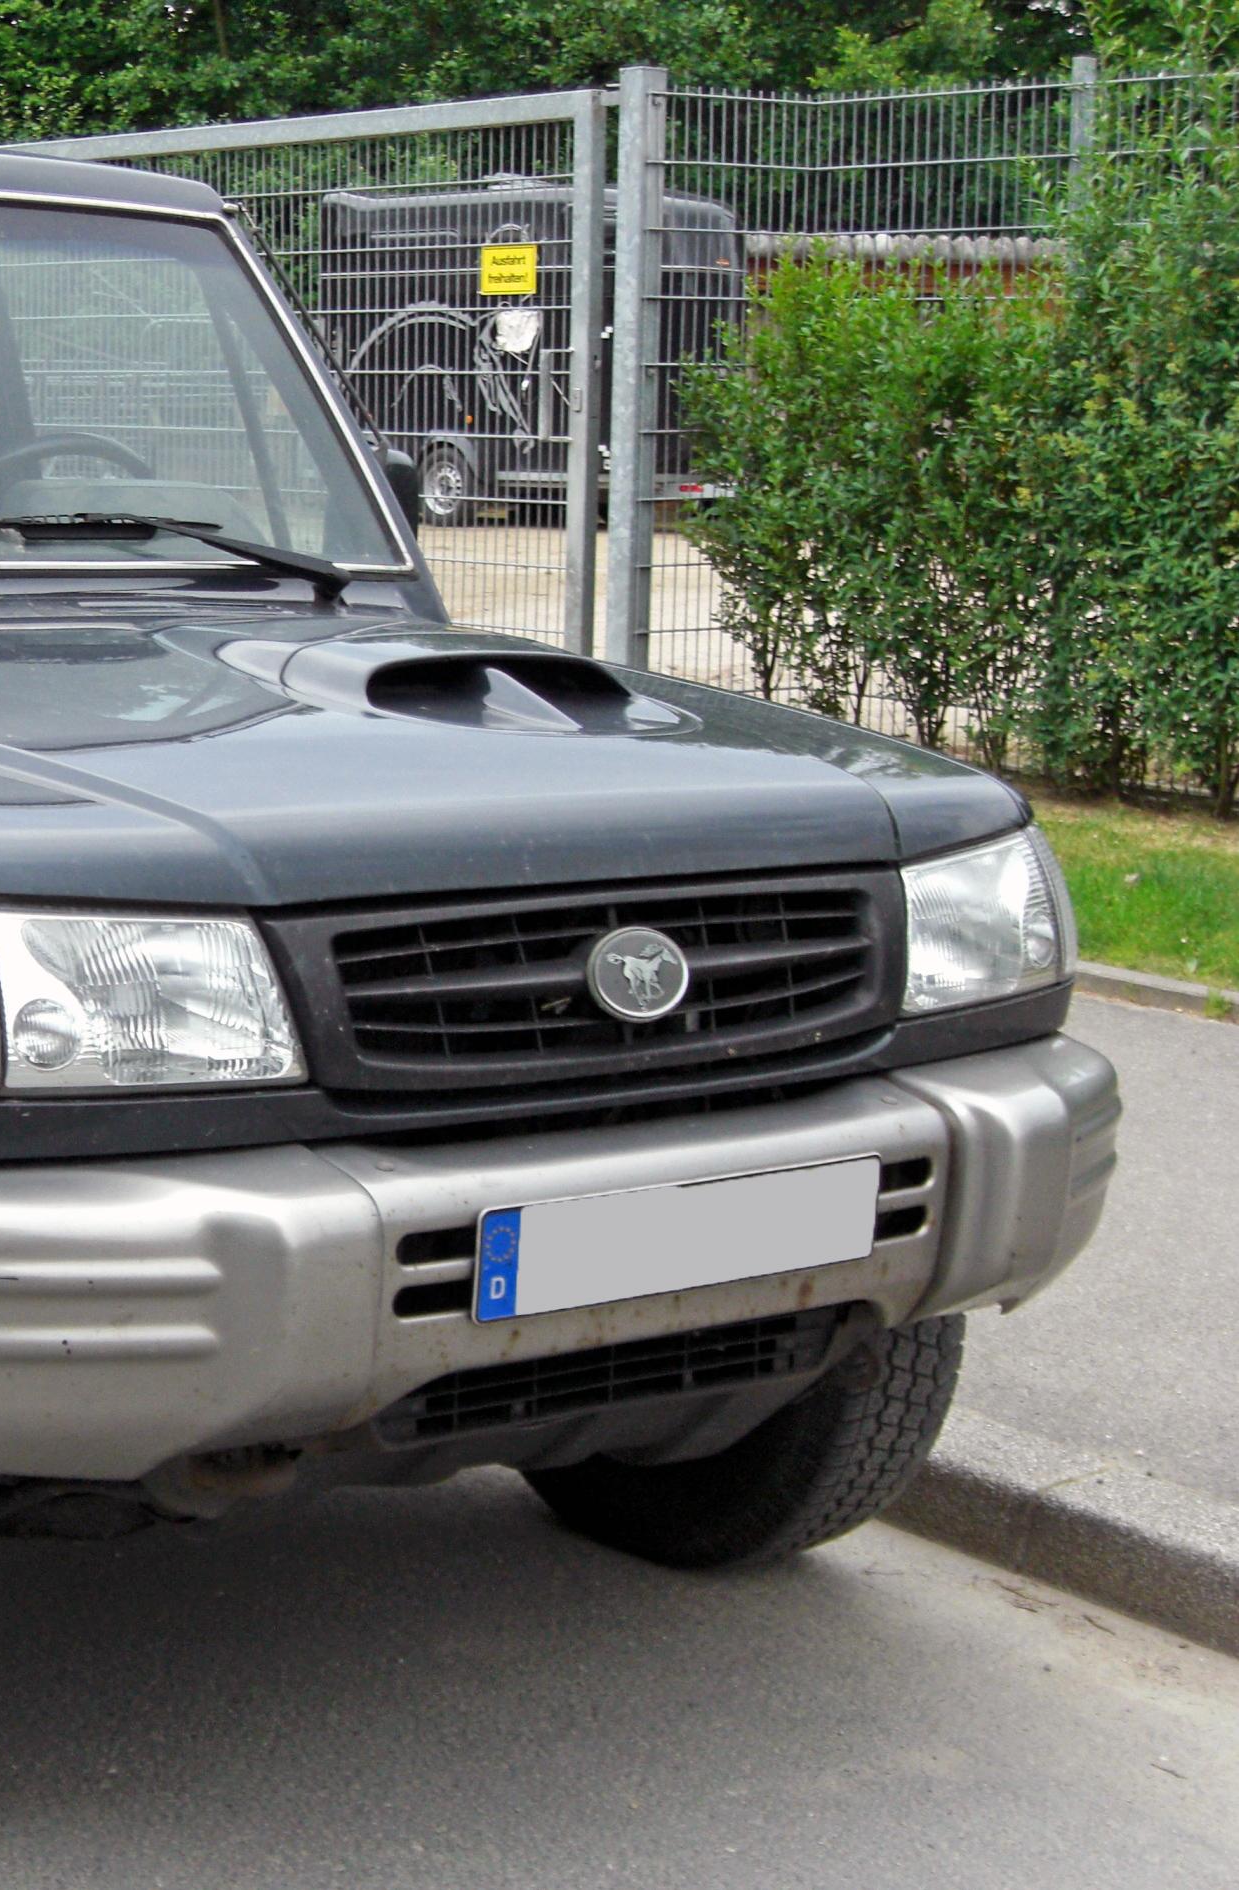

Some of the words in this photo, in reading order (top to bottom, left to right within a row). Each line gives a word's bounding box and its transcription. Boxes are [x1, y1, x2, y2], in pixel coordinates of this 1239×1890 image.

[491, 254, 526, 266] Ausfahrt
[488, 272, 528, 284] freihalten!
[489, 1276, 506, 1300] D
